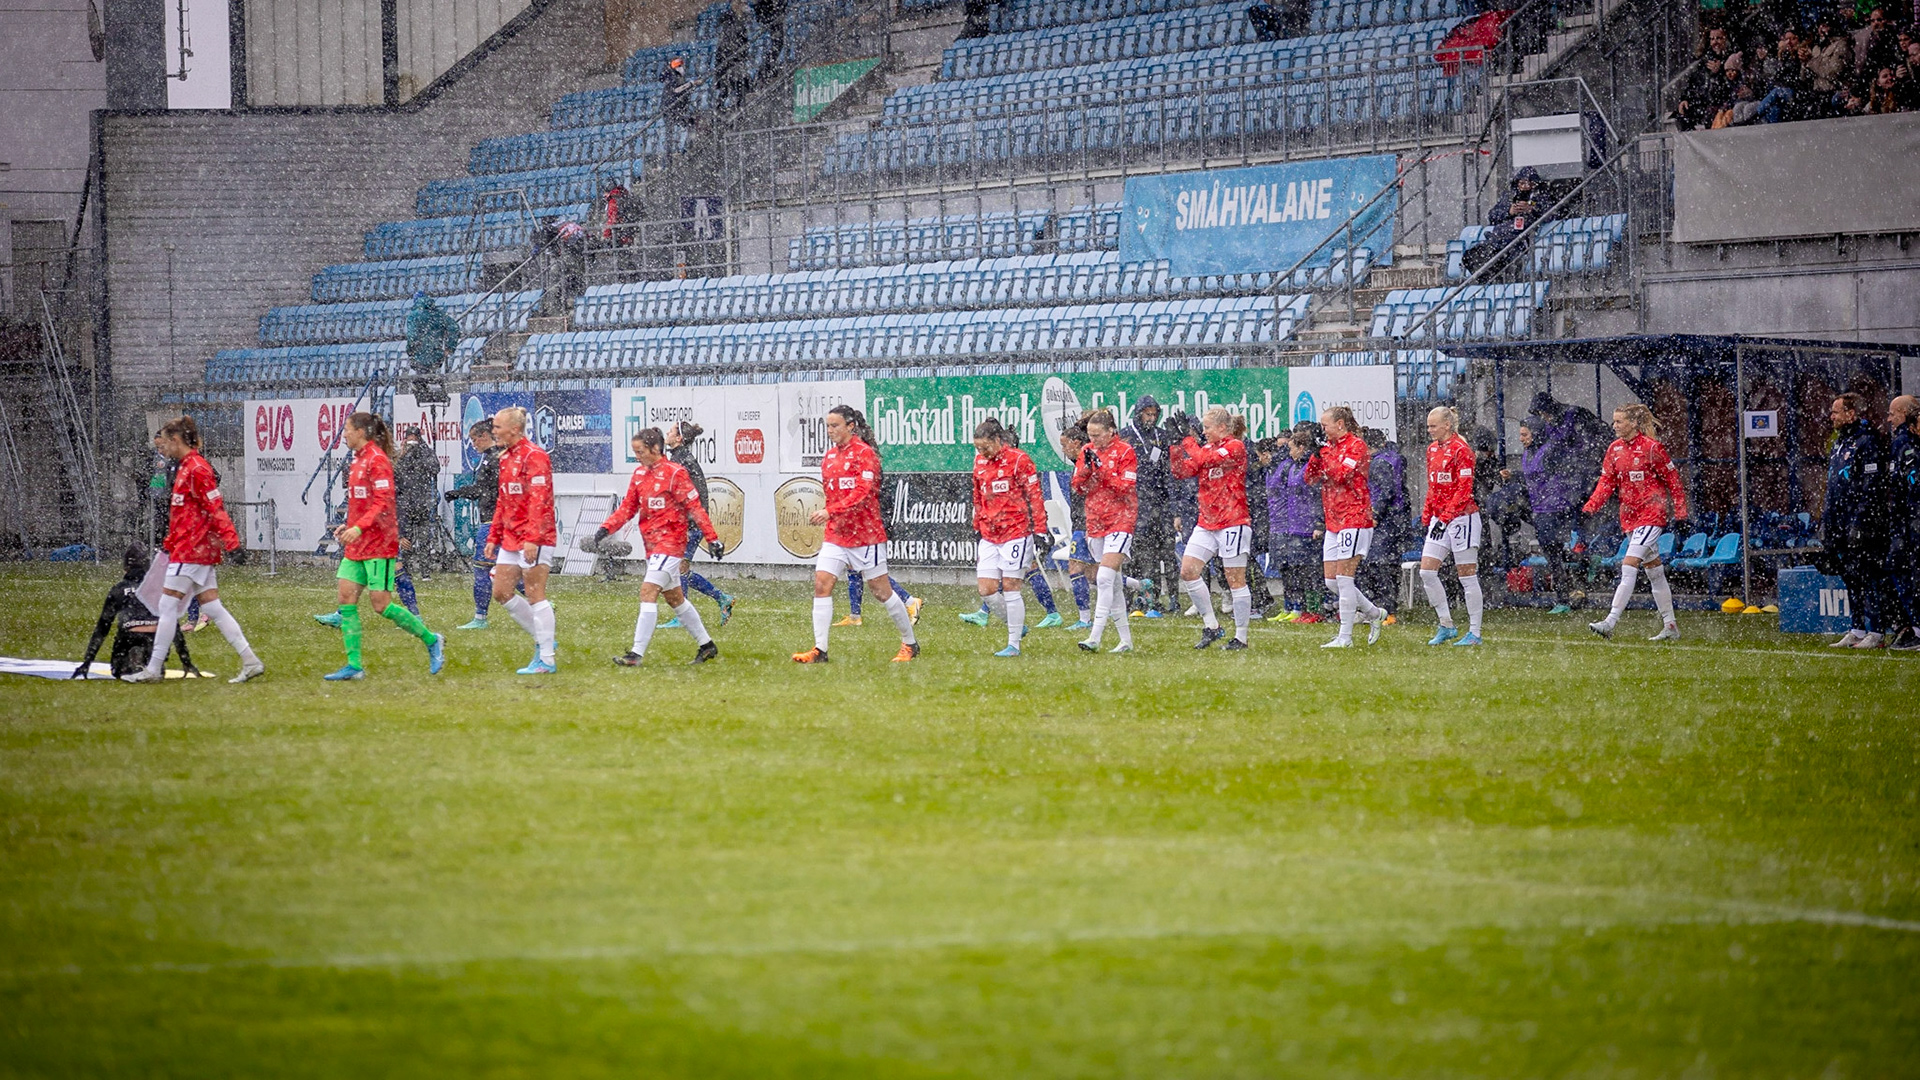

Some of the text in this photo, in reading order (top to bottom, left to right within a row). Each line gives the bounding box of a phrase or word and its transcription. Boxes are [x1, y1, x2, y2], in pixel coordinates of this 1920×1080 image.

[1175, 179, 1333, 231] SMÅHVALANE
[651, 406, 693, 423] SANDEFJORD
[873, 395, 956, 446] Gokstad
[1194, 390, 1281, 442] Atek
[256, 404, 294, 452] evo
[891, 479, 967, 526] Marcussen
[1225, 531, 1237, 547] 17
[1341, 532, 1353, 548] 18
[1454, 524, 1467, 540] 21
[886, 540, 928, 560] BAKERI
[931, 540, 938, 560] &
[1011, 544, 1020, 559] 8
[373, 560, 378, 577] 1
